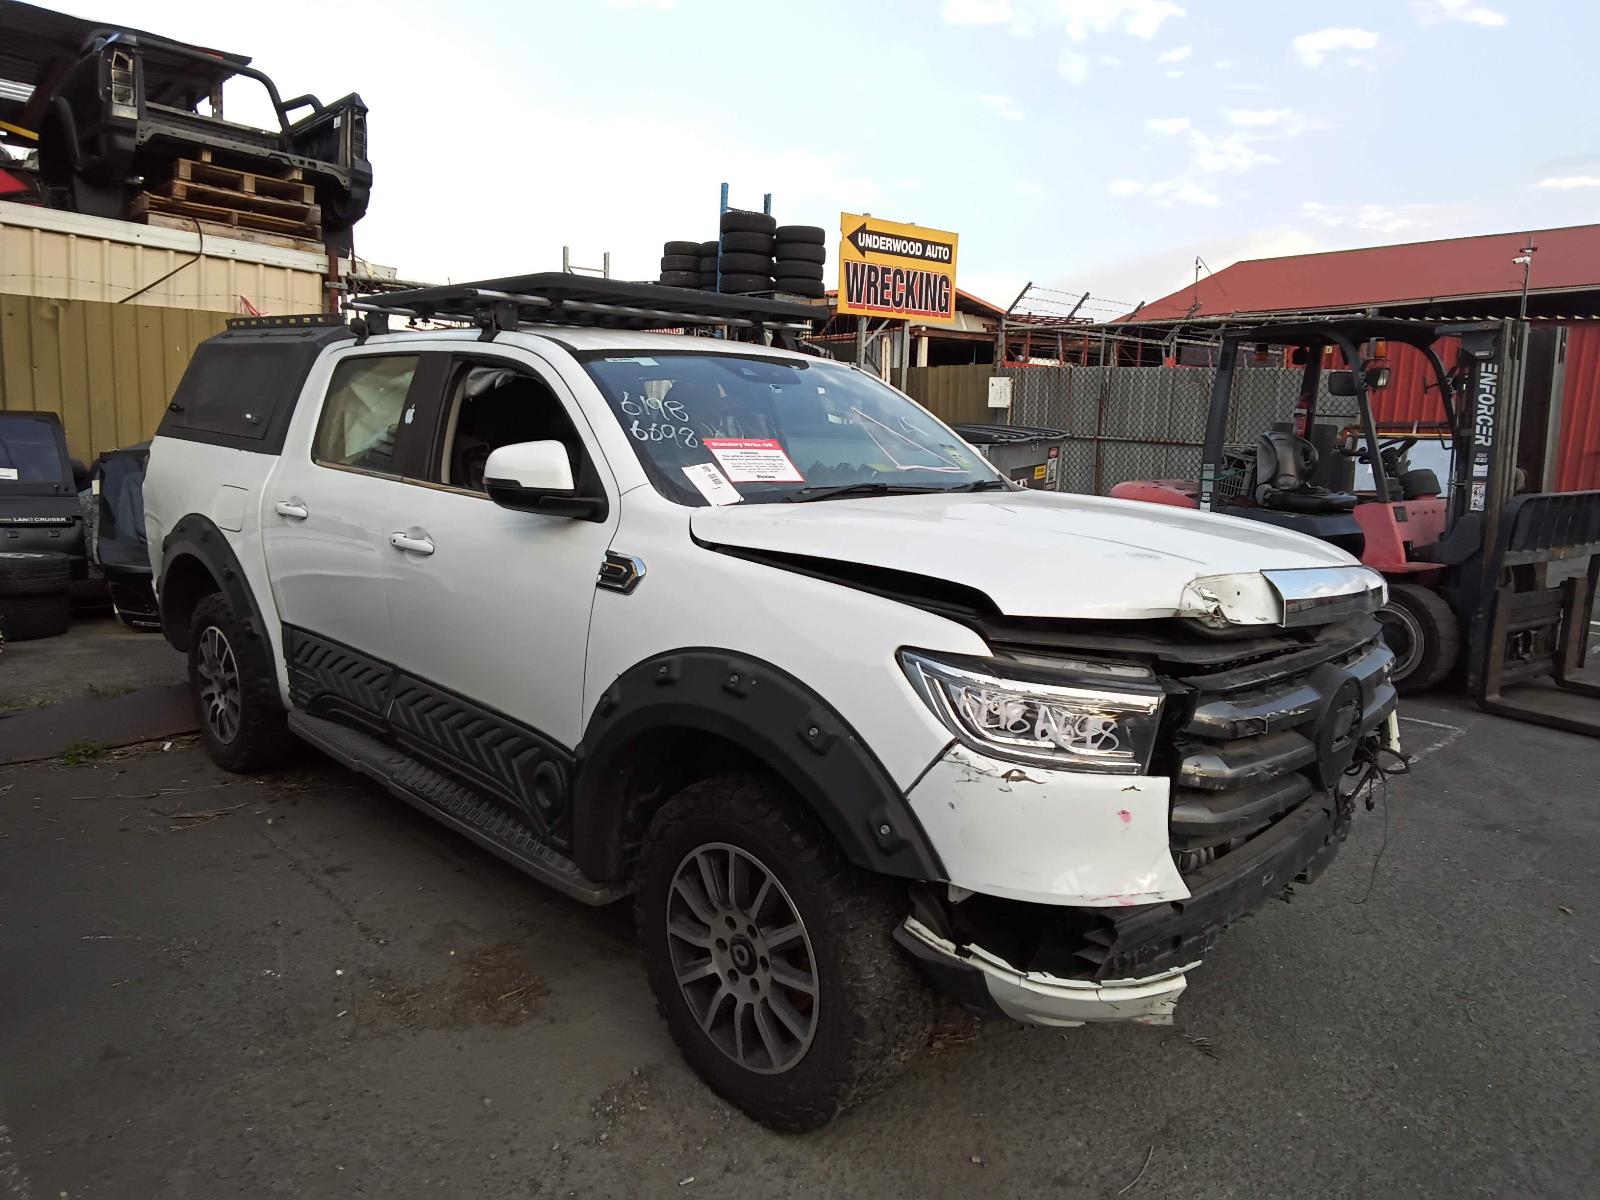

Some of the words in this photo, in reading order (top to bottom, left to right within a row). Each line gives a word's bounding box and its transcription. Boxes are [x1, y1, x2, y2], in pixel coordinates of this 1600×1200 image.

[858, 233, 922, 256] UNDERWOOD
[925, 244, 950, 260] AUTO
[844, 260, 951, 315] WRECKING
[620, 390, 689, 422] 6198
[1474, 362, 1499, 447] ENFORCER
